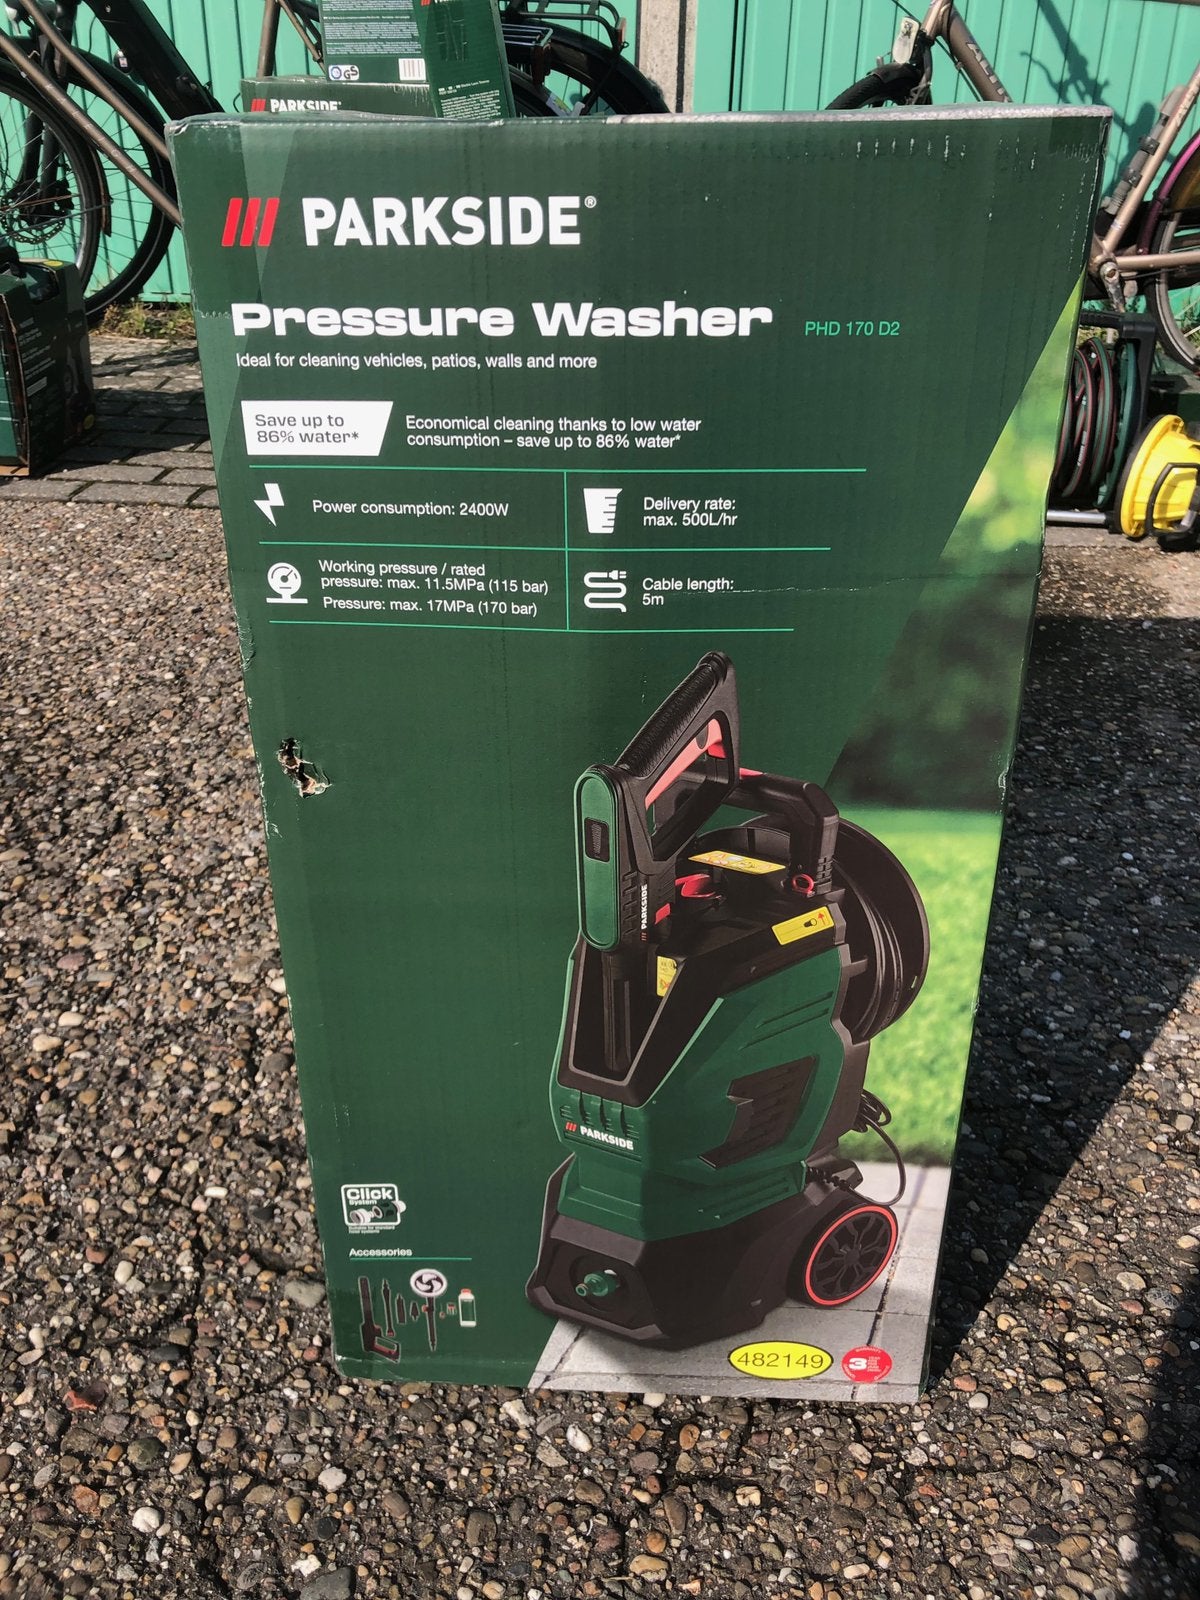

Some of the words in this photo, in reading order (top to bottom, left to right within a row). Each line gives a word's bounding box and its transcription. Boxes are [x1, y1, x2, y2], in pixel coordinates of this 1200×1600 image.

[231, 303, 514, 336] Pressure
[532, 301, 773, 337] Washer
[805, 321, 840, 336] PHD
[846, 321, 873, 336] 170
[879, 321, 900, 336] D2
[236, 353, 271, 367] Ideal
[275, 353, 295, 367] for
[299, 353, 359, 370] cleaning
[363, 354, 427, 369] vehicles,
[432, 354, 480, 370] patios,
[486, 354, 522, 368] walls
[527, 354, 554, 368] and
[559, 357, 597, 368] more
[255, 414, 297, 427] Save
[302, 416, 323, 430] up
[328, 415, 344, 427] to
[406, 415, 489, 431] Economical
[494, 417, 553, 433] cleaning
[558, 417, 607, 431] thanks
[611, 418, 626, 431] to
[630, 417, 655, 431] low
[660, 419, 701, 431] water
[257, 431, 294, 443] 86%
[407, 433, 499, 449] consumption
[517, 437, 550, 447] save
[555, 437, 573, 450] up
[577, 435, 592, 448] to
[596, 434, 630, 448] 86%
[313, 500, 356, 513] Power
[361, 502, 455, 517] consumption:
[460, 503, 509, 516] 2400W
[644, 497, 700, 513] Delivery
[704, 499, 736, 510] rate:
[643, 515, 677, 526] max.
[682, 513, 737, 526] 500L/hr
[319, 560, 375, 575] Working
[379, 563, 438, 575] pressure
[451, 564, 486, 576] rated
[321, 576, 383, 588] pressure:
[387, 579, 420, 590] max.
[425, 577, 485, 592] 11.5MPa
[489, 579, 518, 594] (115
[522, 580, 549, 595] bar)
[642, 578, 683, 590] Cable
[687, 578, 734, 592] length:
[323, 597, 386, 610] Pressure:
[390, 600, 423, 611] max.
[428, 600, 475, 613] 17MPa
[478, 601, 507, 616] (170
[511, 602, 538, 617] bar)
[642, 594, 664, 605] 5m
[580, 1126, 634, 1150] PARKSIDE
[347, 1188, 393, 1200] Click
[349, 1248, 413, 1258] Accessories
[737, 1352, 824, 1369] 482149
[849, 1357, 868, 1370] 3
